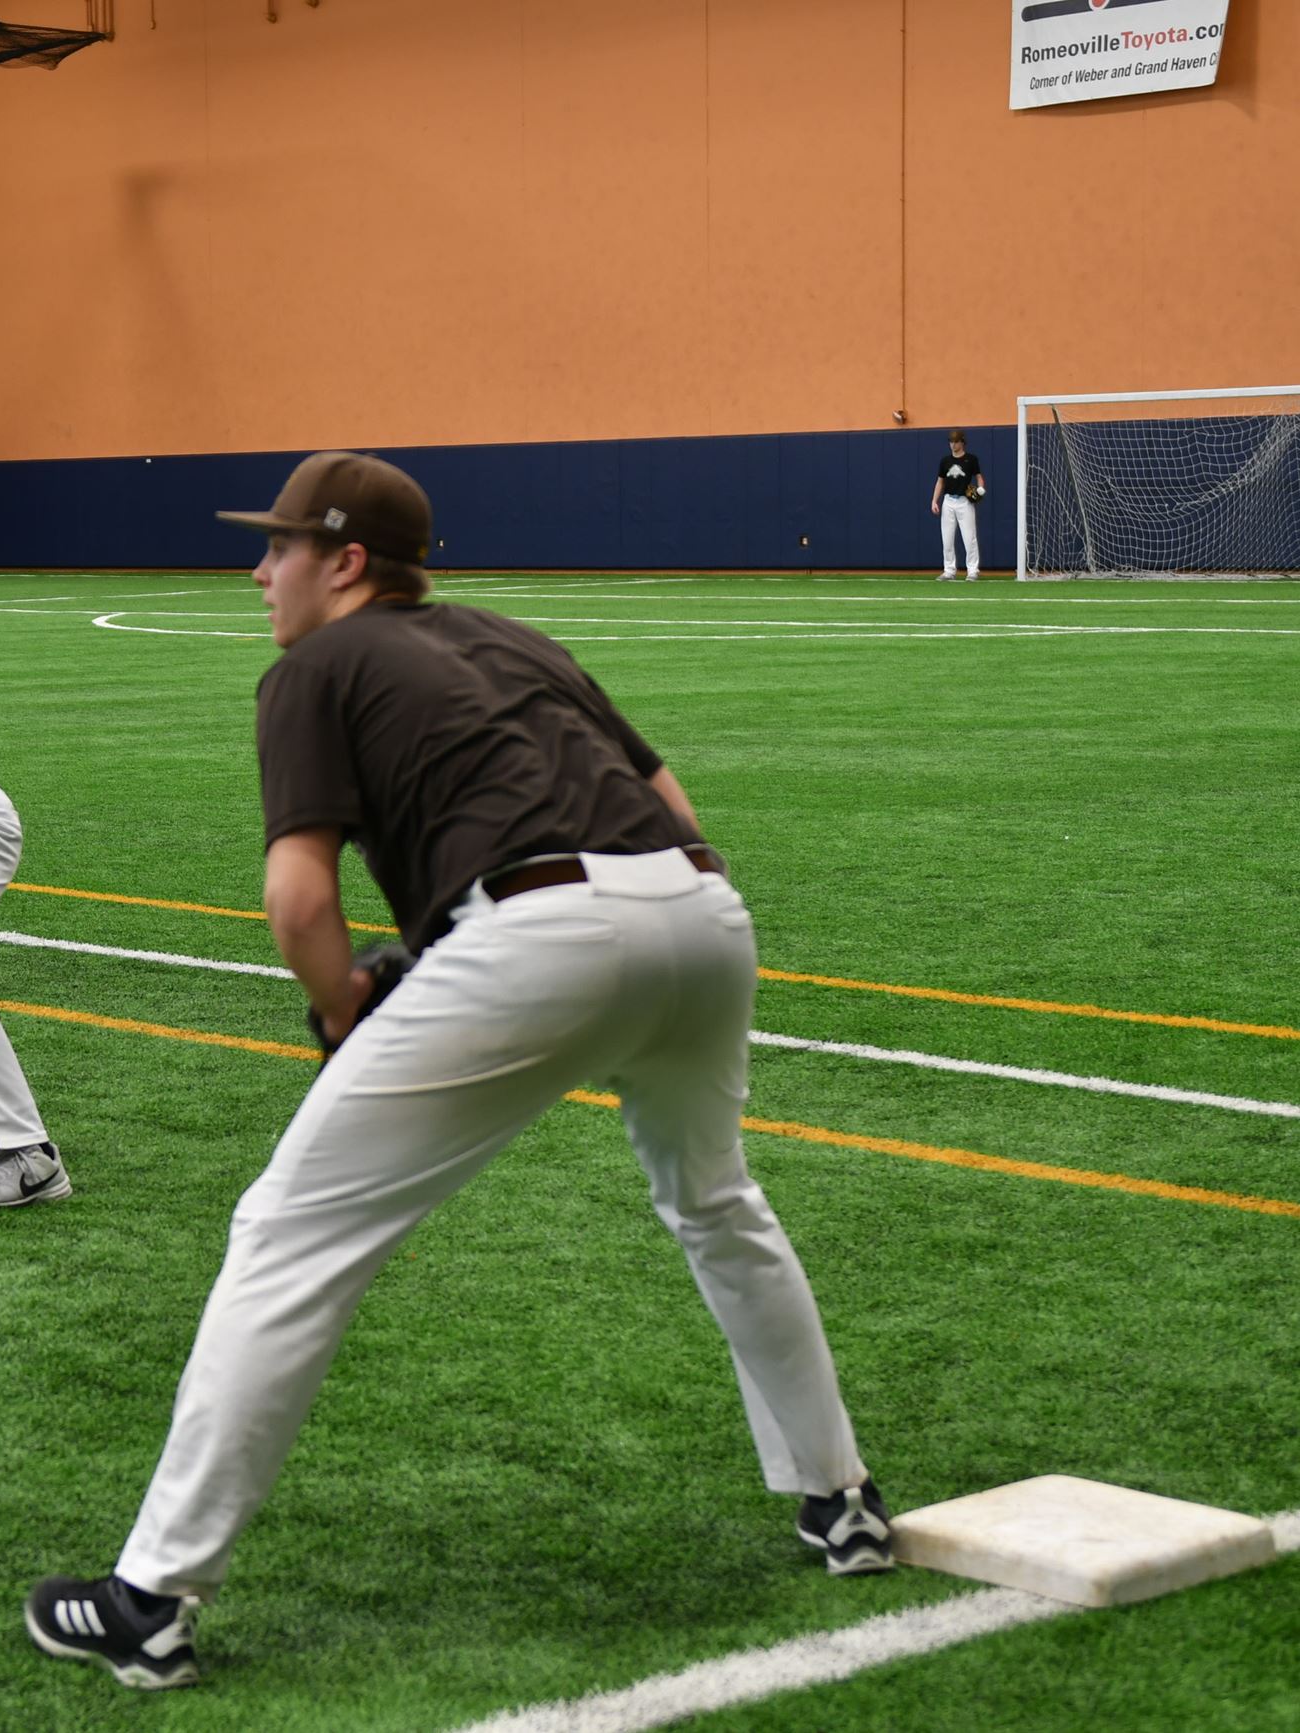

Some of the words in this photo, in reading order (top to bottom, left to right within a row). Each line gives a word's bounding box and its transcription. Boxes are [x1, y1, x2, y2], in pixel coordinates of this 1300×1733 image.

[1030, 75, 1059, 90] Corner
[1061, 70, 1073, 85] of
[1075, 68, 1109, 83] Weber
[1111, 64, 1132, 78] and
[1135, 59, 1168, 75] Grand
[1171, 57, 1207, 71] Haven
